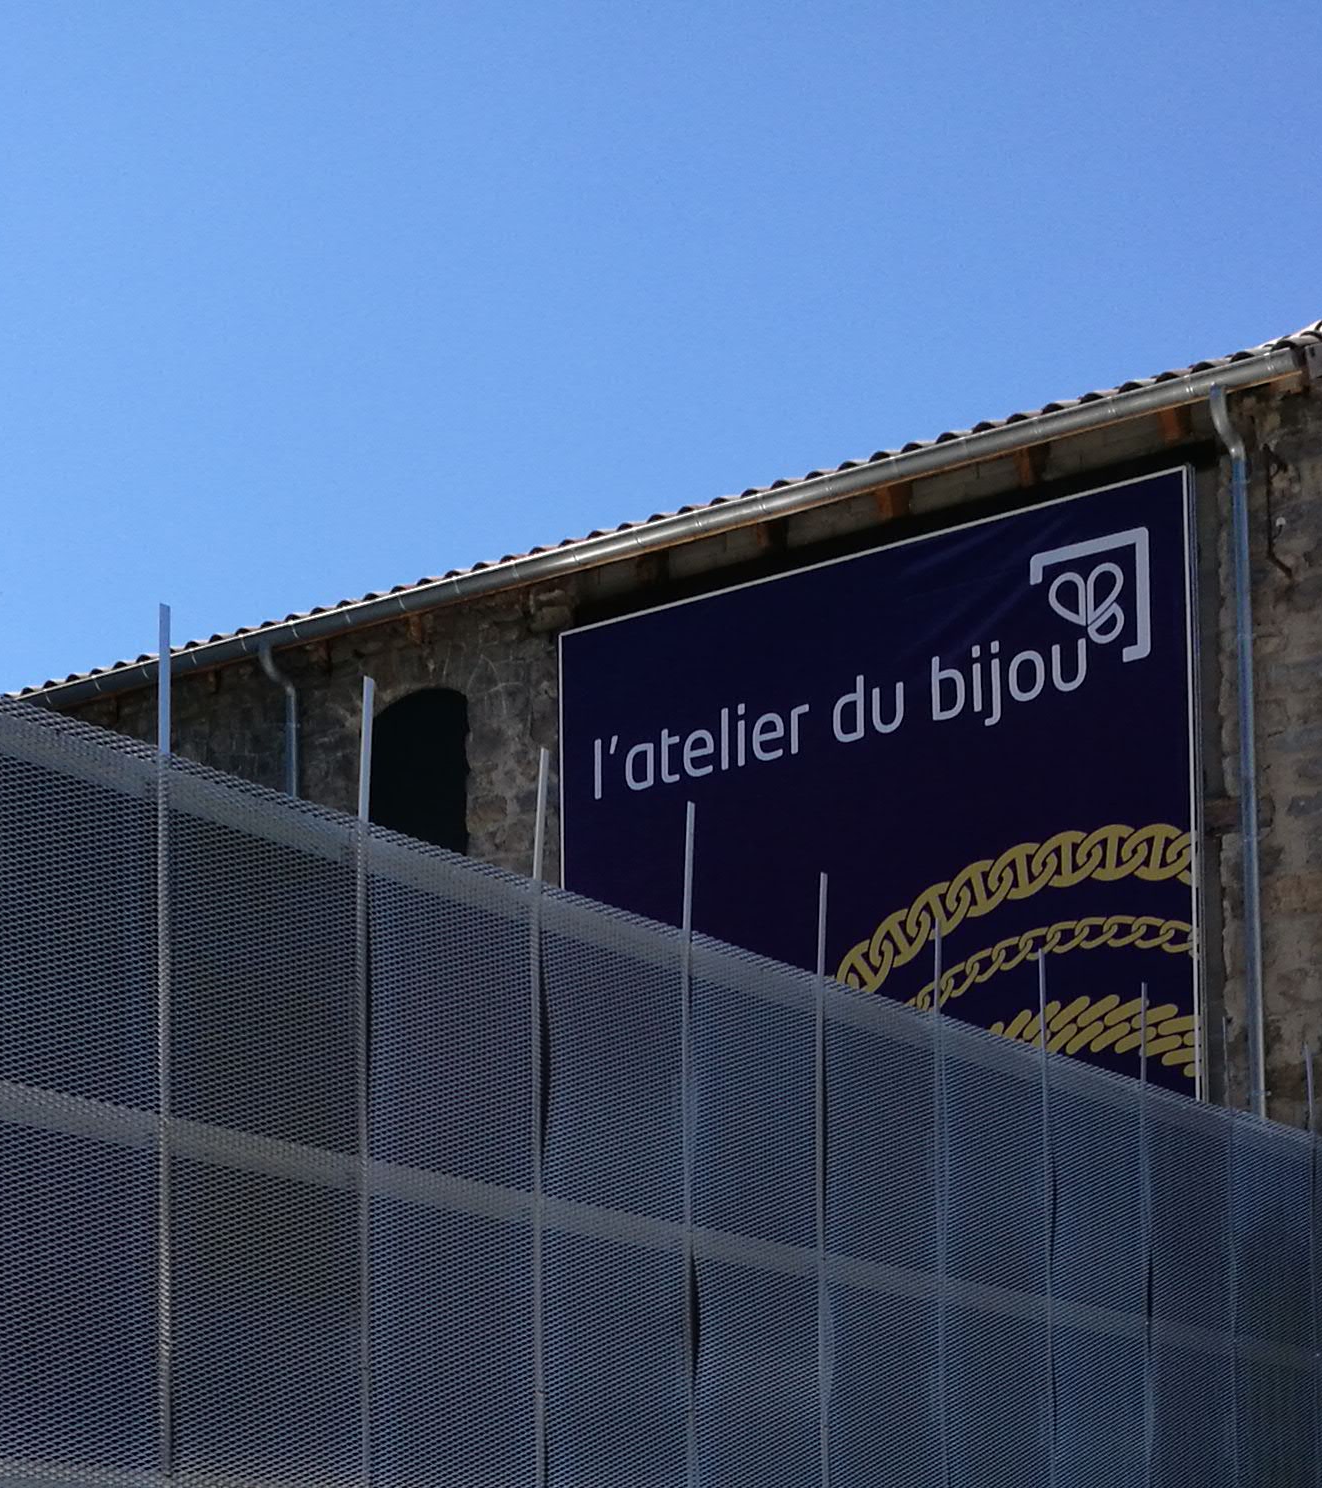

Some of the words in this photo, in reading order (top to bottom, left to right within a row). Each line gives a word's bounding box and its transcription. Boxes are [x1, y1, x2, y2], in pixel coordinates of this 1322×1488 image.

[593, 703, 810, 799] l'atelier
[832, 674, 905, 744] du
[930, 637, 1089, 727] bijou
